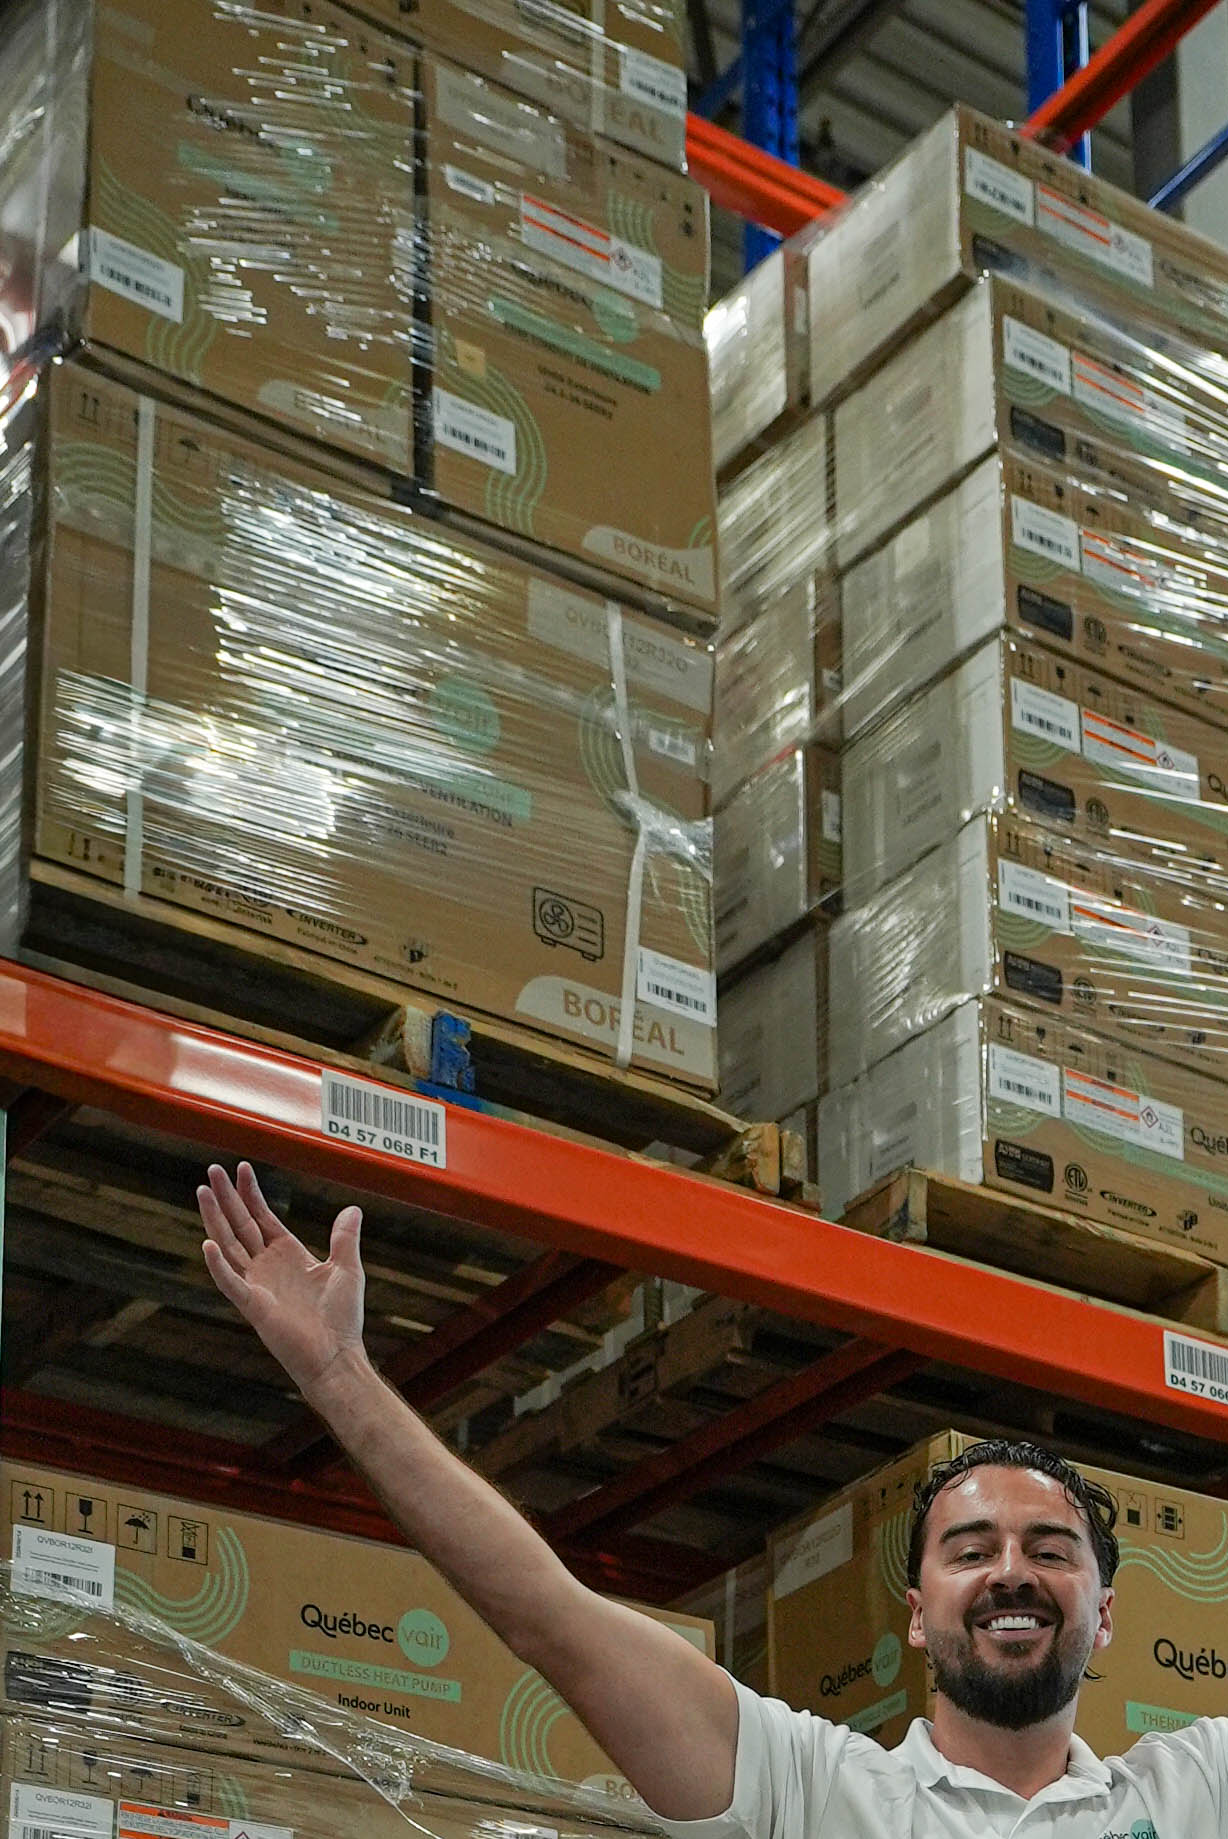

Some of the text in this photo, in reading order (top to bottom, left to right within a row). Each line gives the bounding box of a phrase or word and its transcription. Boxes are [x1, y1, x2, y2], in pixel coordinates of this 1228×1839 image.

[328, 1120, 438, 1163] D4 57 068 F1
[1170, 1374, 1187, 1388] D4
[1191, 1380, 1205, 1393] 57
[300, 1603, 444, 1650] Québec vair
[301, 1656, 450, 1695] DUCTLESS HEAT PUMP
[338, 1693, 410, 1720] Indoor Unit
